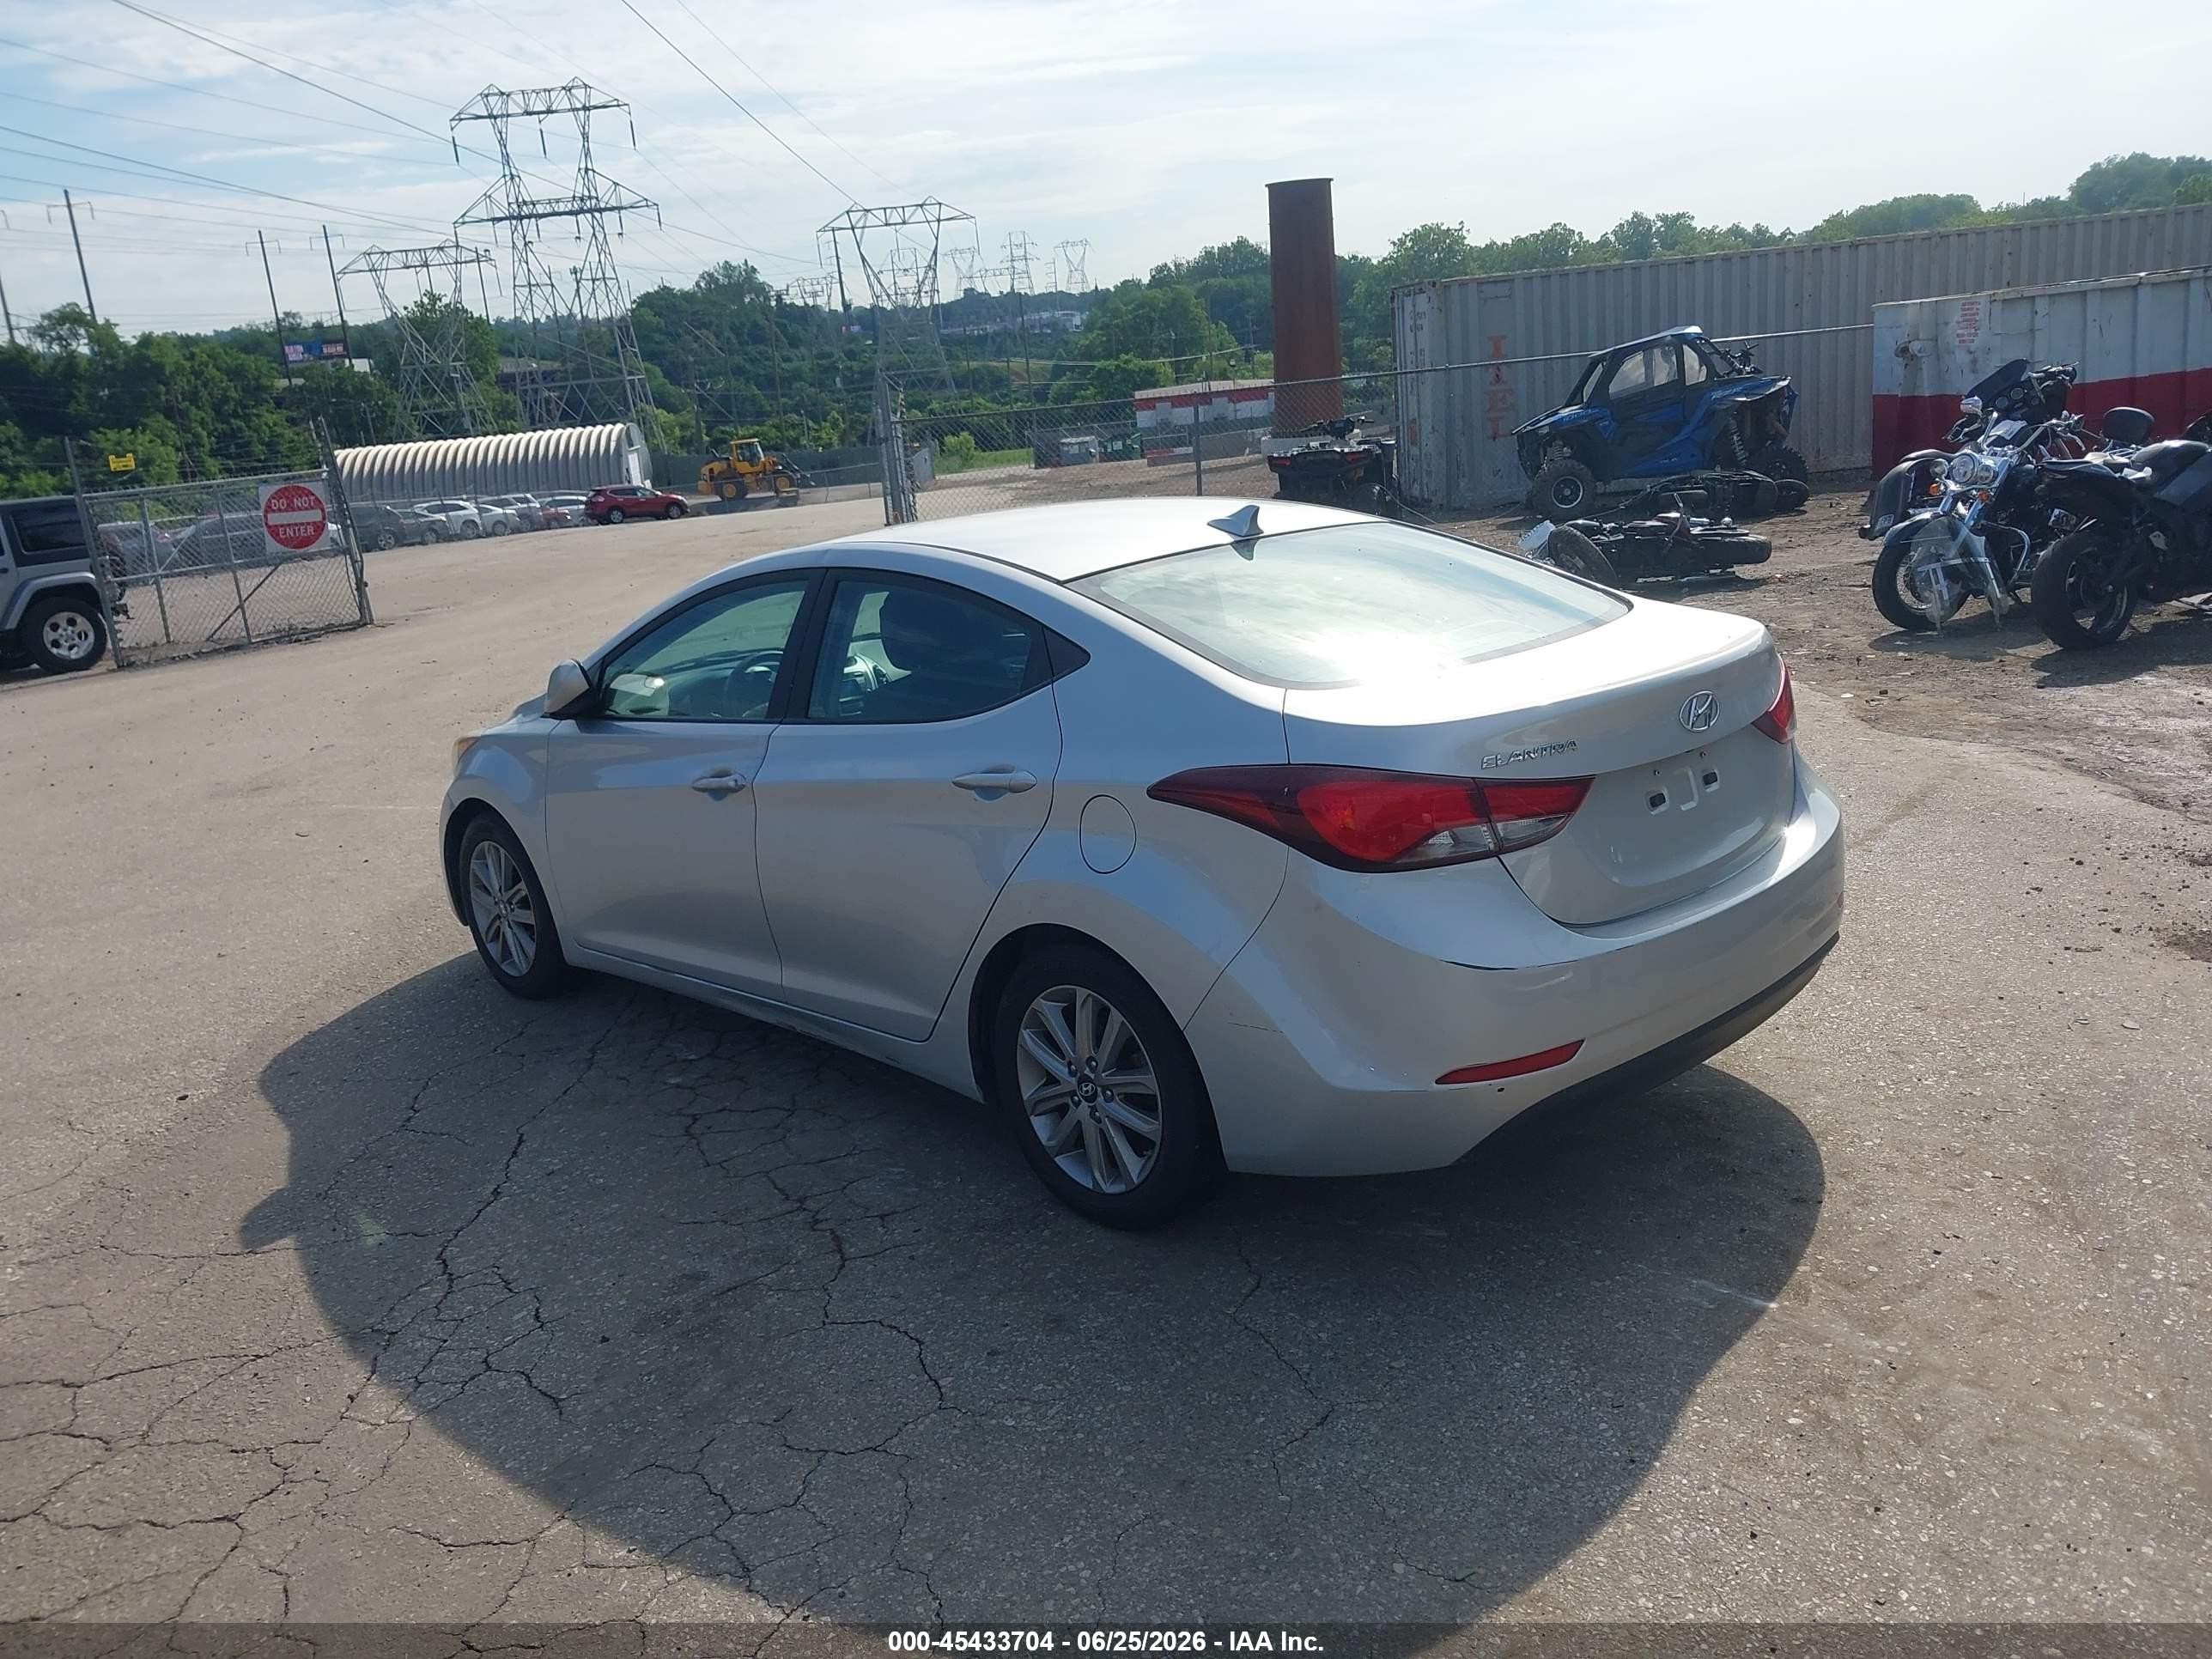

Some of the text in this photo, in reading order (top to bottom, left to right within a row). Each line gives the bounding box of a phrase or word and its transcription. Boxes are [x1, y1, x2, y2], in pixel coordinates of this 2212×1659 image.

[270, 496, 316, 510] DO NOT
[279, 526, 315, 538] ENTER
[1481, 739, 1577, 769] ELANTRA
